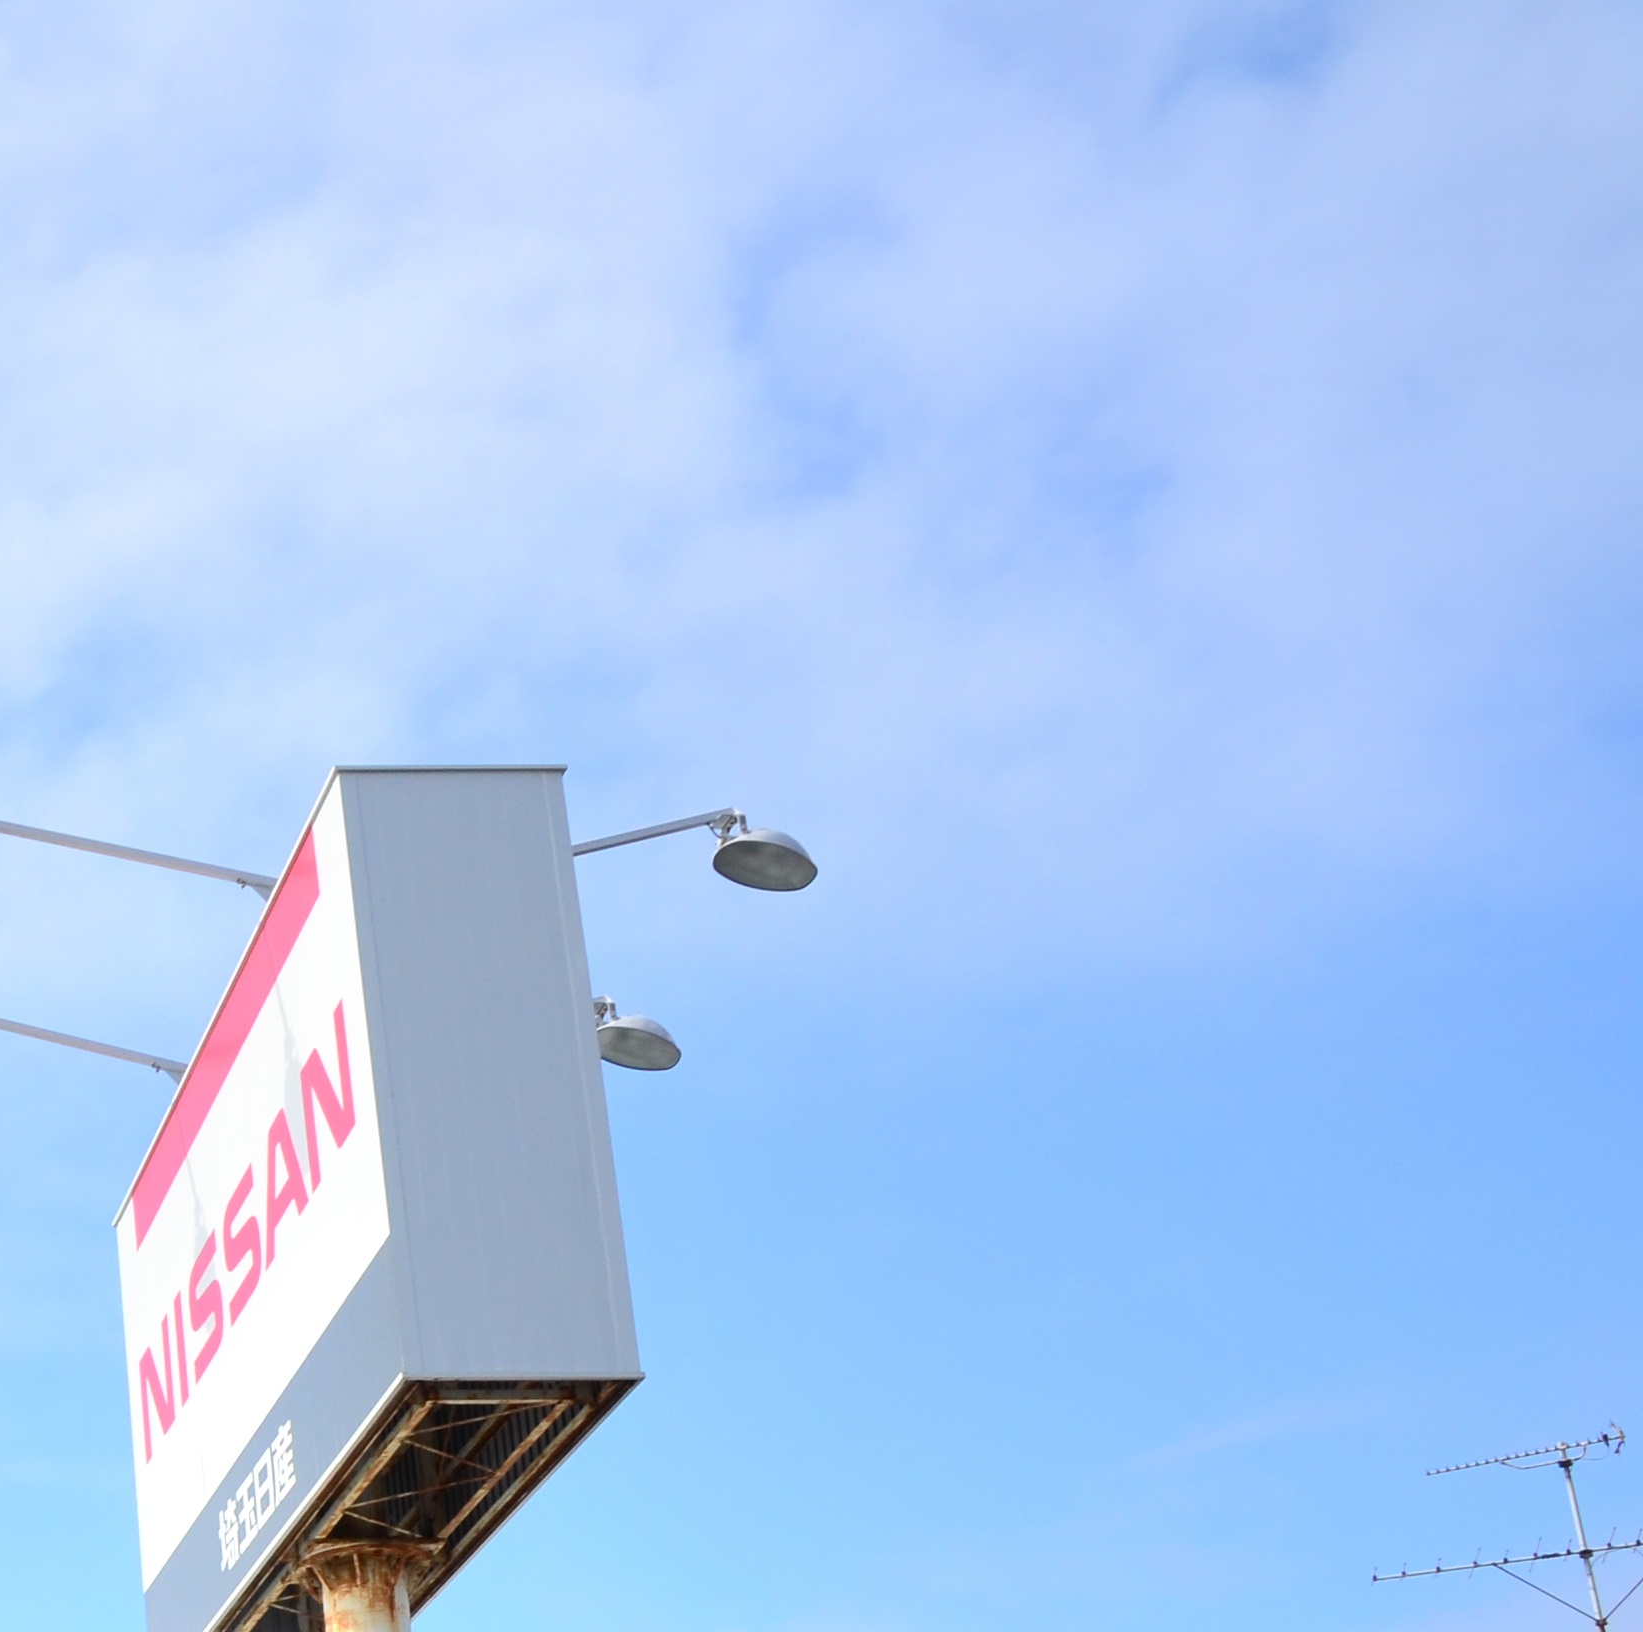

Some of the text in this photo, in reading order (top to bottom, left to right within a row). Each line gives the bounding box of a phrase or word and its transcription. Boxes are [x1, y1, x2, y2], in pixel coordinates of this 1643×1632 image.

[137, 999, 356, 1465] NISSAN
[218, 1419, 297, 1572] 埼玉日産
